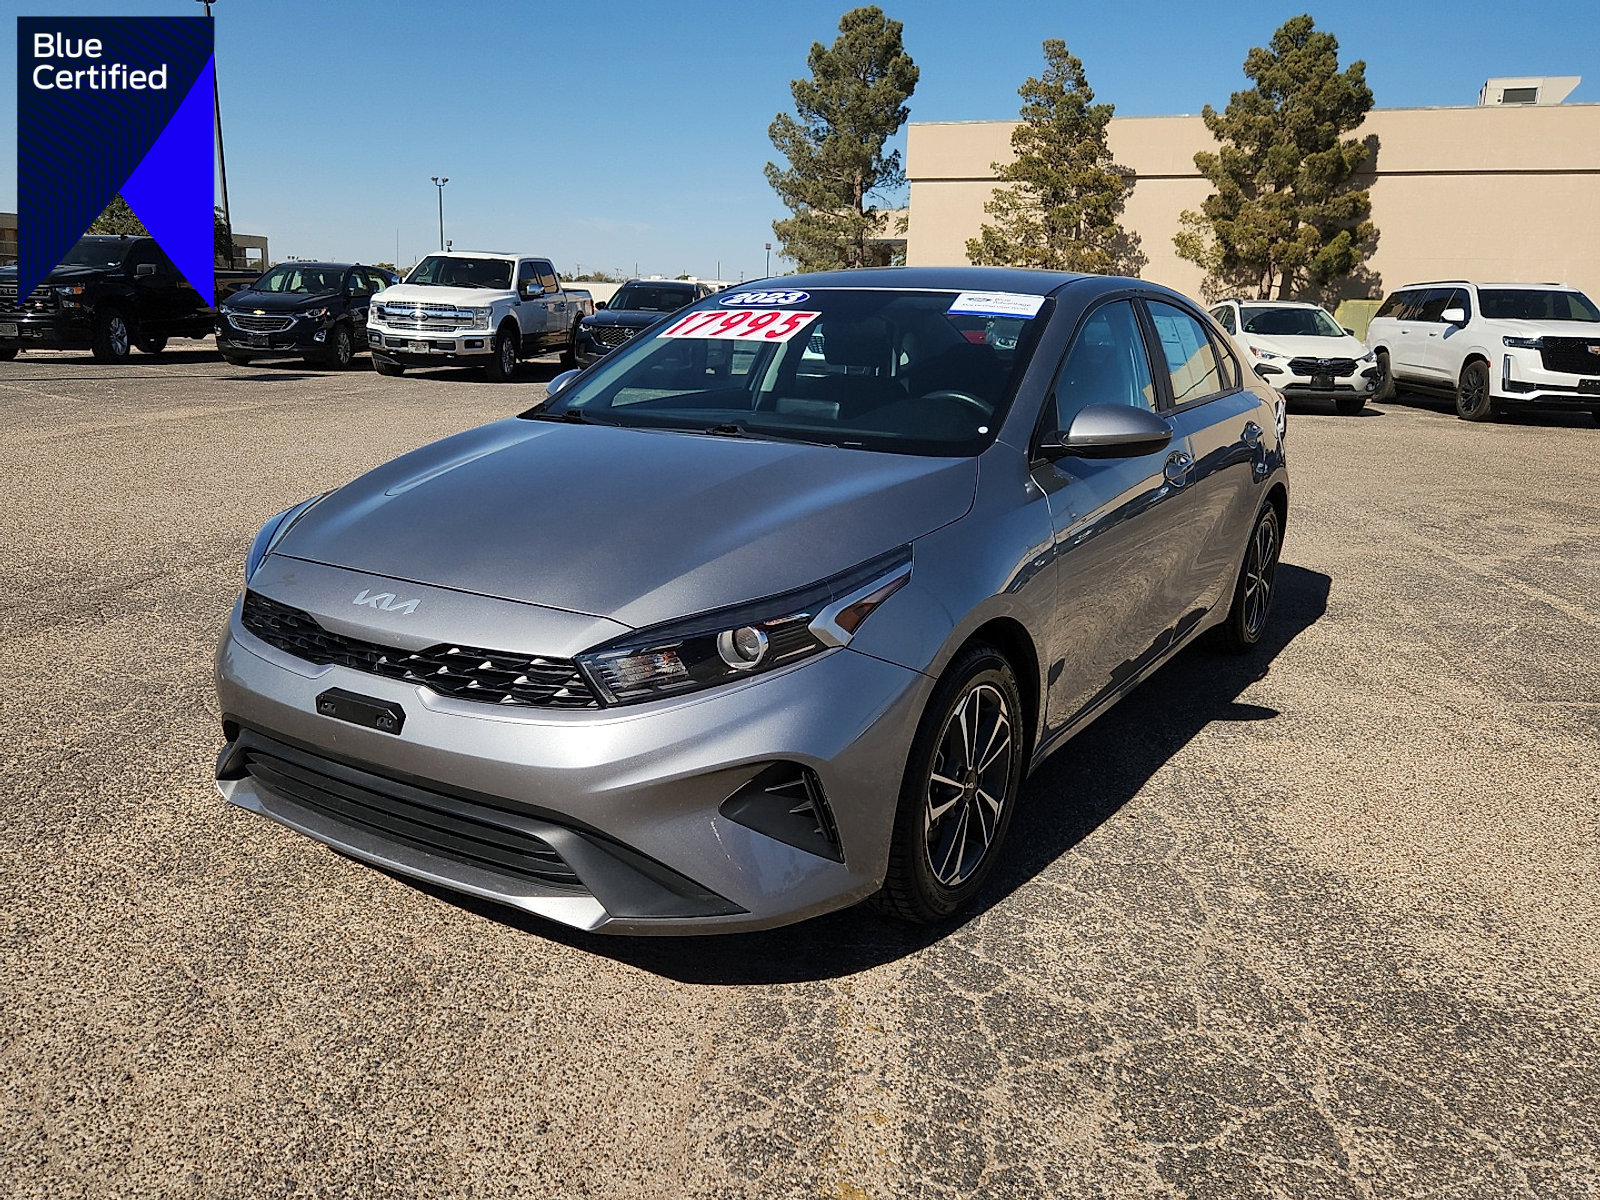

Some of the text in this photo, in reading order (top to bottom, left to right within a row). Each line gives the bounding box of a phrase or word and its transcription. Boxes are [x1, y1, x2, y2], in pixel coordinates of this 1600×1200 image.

[732, 291, 801, 305] 2023
[665, 311, 815, 339] 17995
[352, 588, 422, 615] KIA
